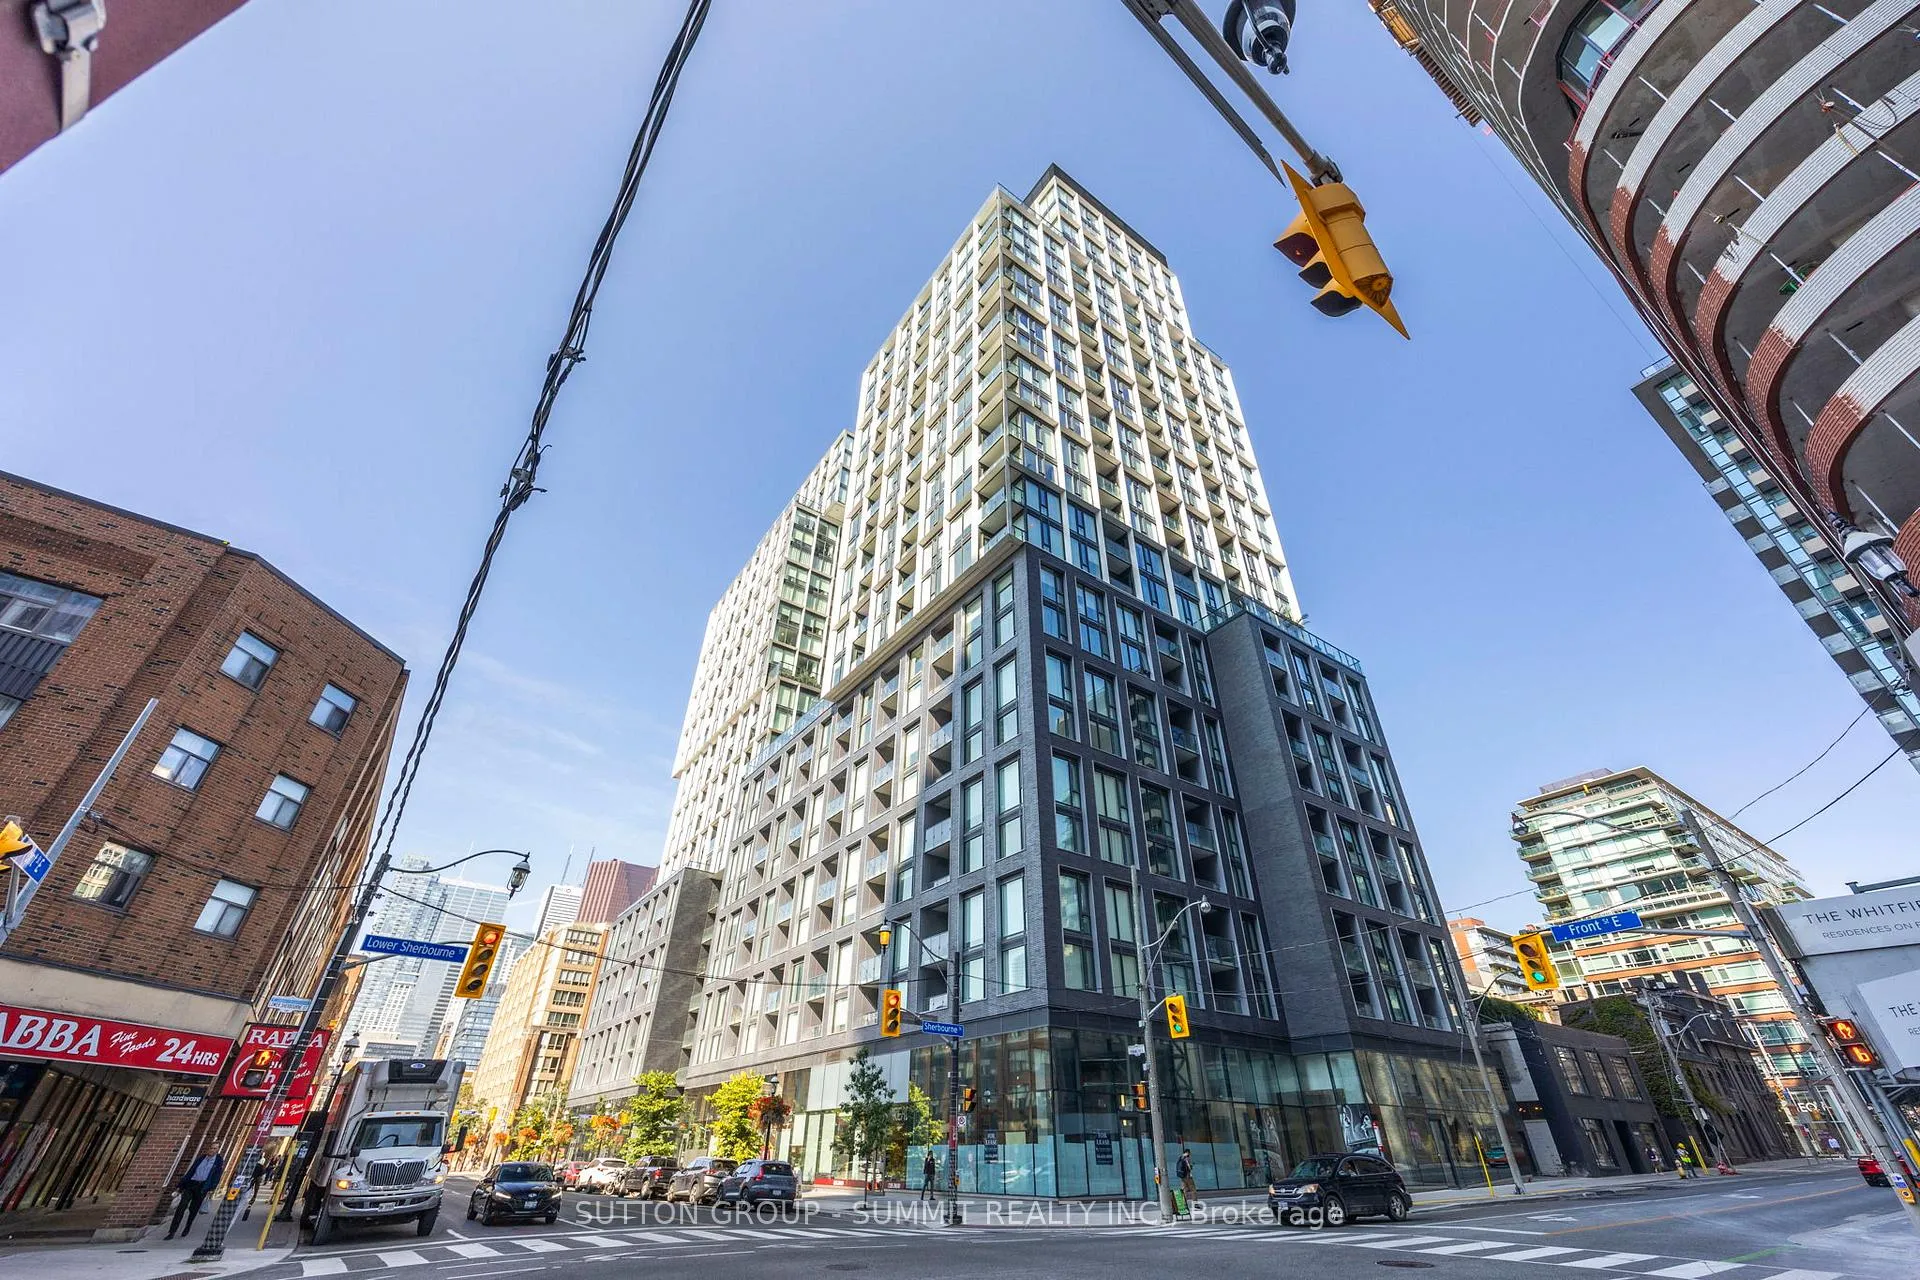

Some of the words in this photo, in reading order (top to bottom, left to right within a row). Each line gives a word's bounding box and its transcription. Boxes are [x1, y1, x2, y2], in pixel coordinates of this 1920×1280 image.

[1568, 920, 1602, 935] Front
[1602, 917, 1610, 925] St
[1611, 916, 1622, 927] E
[1802, 911, 1842, 924] THE
[1822, 925, 1892, 939] RESIDENCES
[1894, 923, 1913, 931] ON
[366, 937, 398, 950] Lower
[400, 941, 455, 958] Sherbourne
[1888, 1003, 1918, 1018] THE
[924, 1022, 958, 1034] Sherbourne
[109, 1031, 138, 1048] Fine
[120, 1037, 157, 1057] Foods
[156, 1038, 197, 1064] 24
[191, 1051, 219, 1066] HRS
[170, 1086, 191, 1095] PRO
